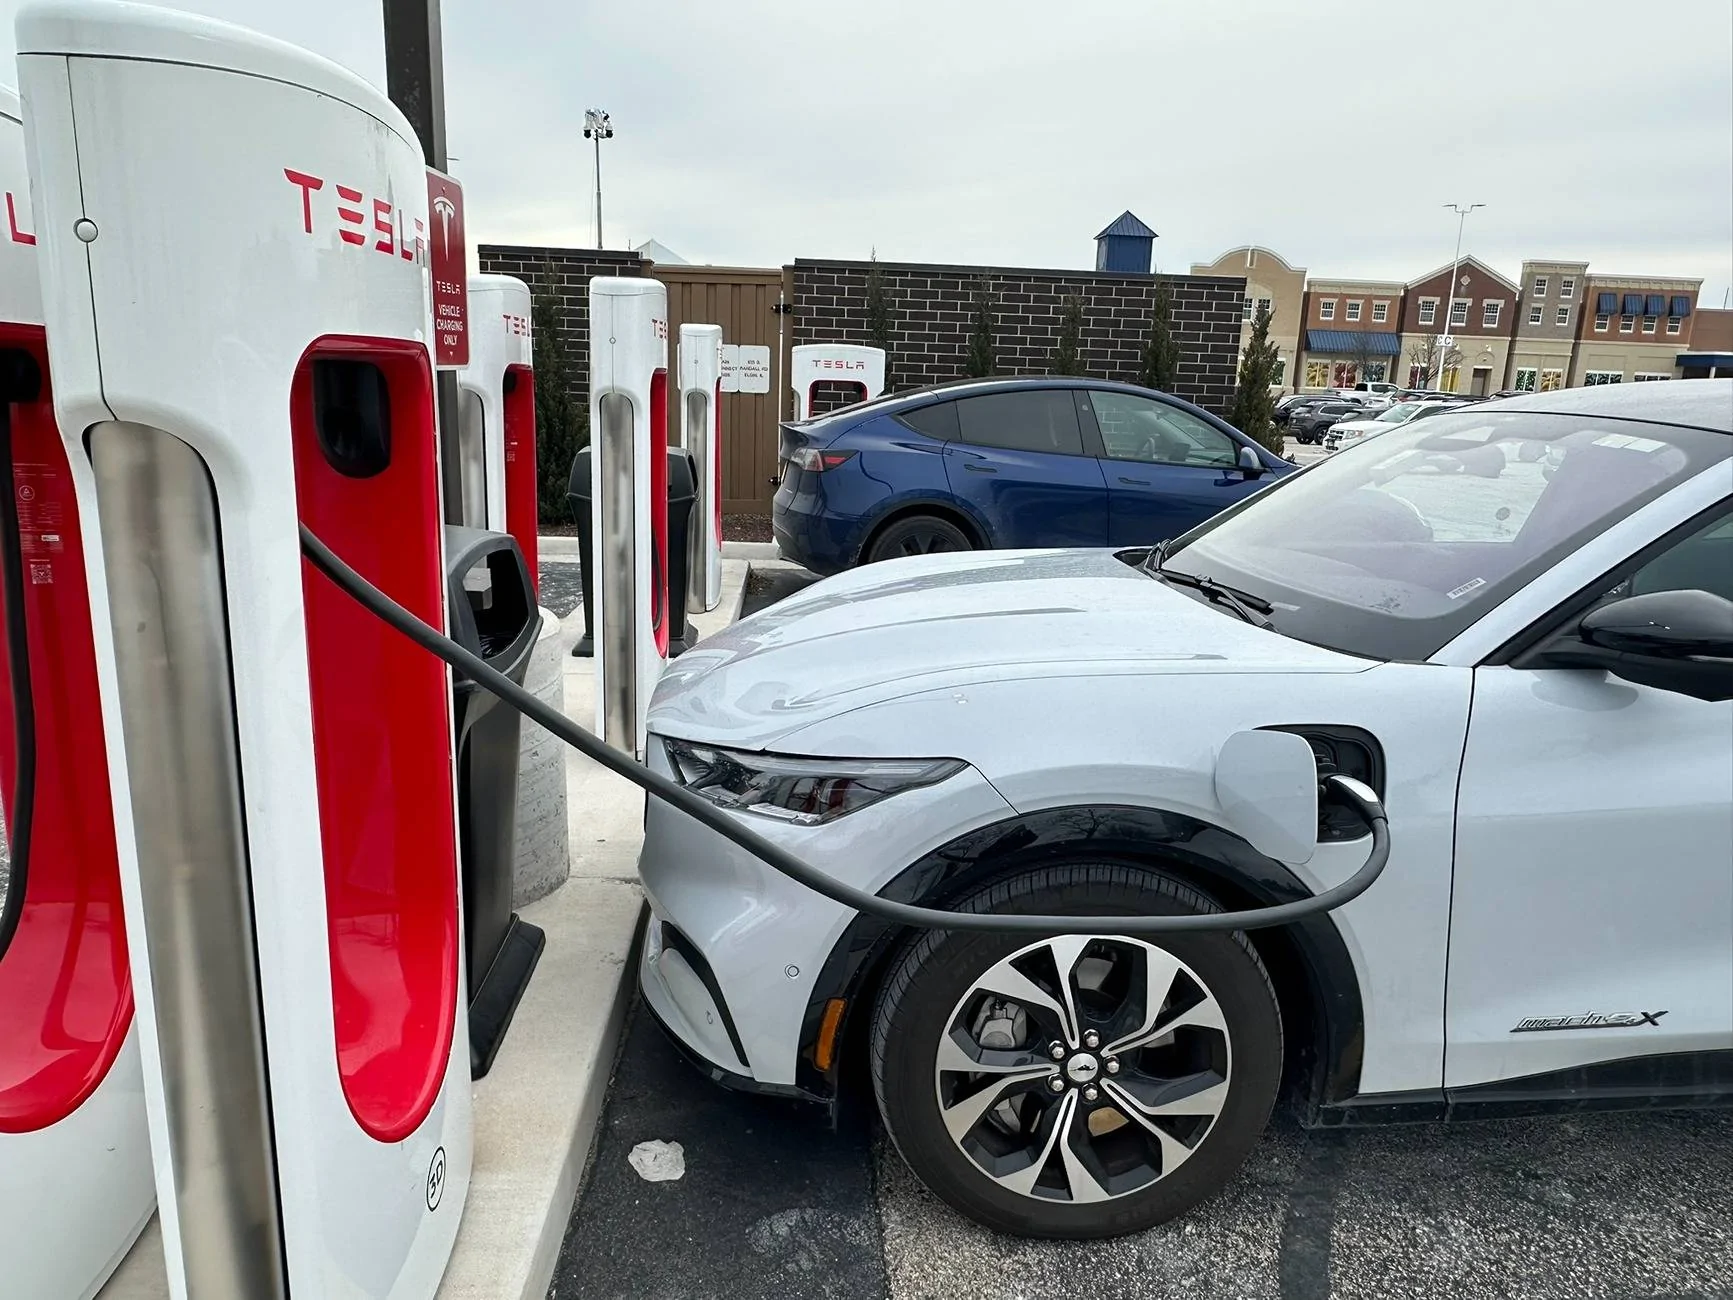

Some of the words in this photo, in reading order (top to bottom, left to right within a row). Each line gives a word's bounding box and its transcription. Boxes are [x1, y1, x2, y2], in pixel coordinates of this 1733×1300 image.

[284, 168, 425, 267] TESLA
[436, 280, 461, 294] TESLA
[438, 304, 460, 317] VEHICLE
[436, 319, 463, 332] CHARGING
[443, 334, 458, 345] ONLY
[812, 359, 865, 370] TESLA
[429, 1160, 443, 1199] 3D
